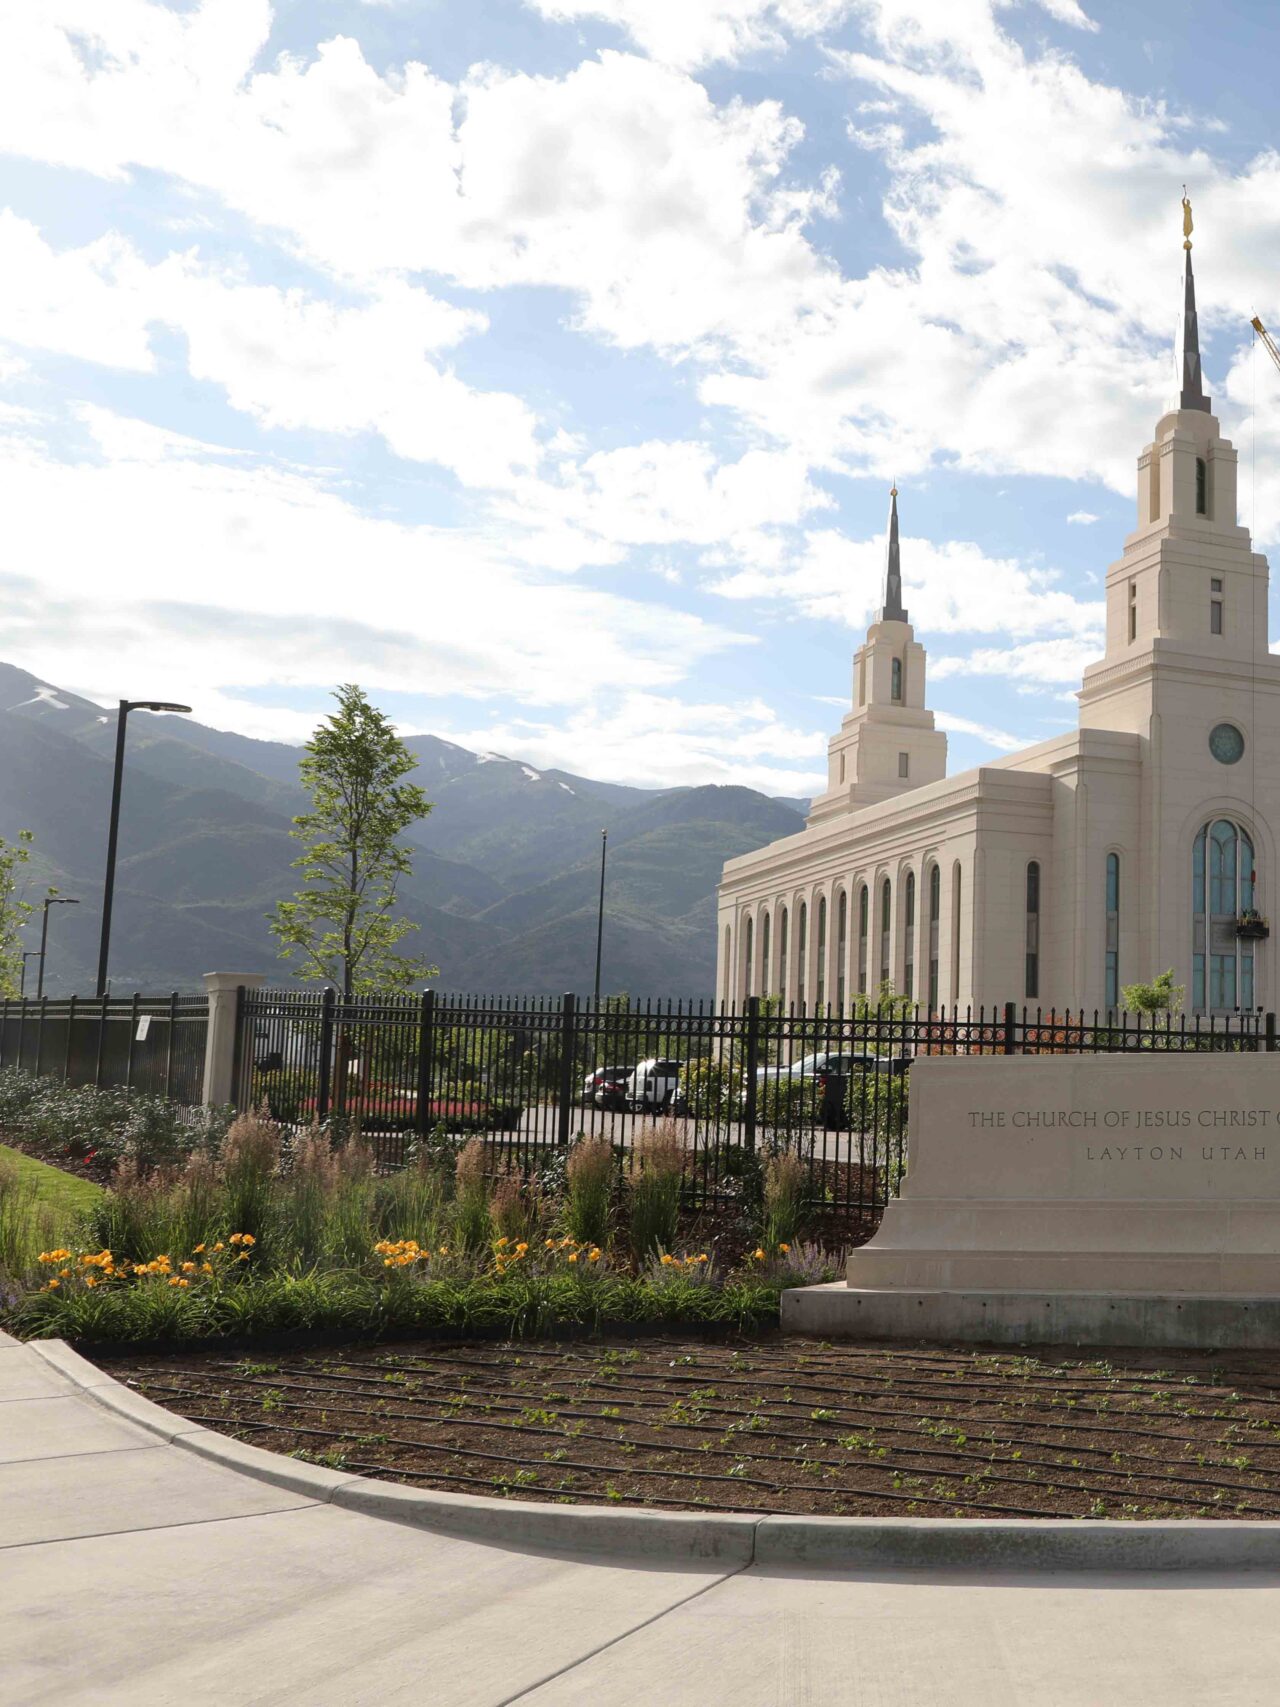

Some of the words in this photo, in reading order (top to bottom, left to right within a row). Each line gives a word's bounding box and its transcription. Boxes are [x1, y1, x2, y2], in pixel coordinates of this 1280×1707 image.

[968, 1111, 1006, 1128] THE
[1011, 1111, 1098, 1128] CHURCH
[1103, 1110, 1130, 1127] OF
[1136, 1110, 1191, 1128] JESUS
[1197, 1110, 1271, 1127] CHRIST
[1086, 1146, 1183, 1161] LAYTON
[1201, 1146, 1266, 1161] UTAH
